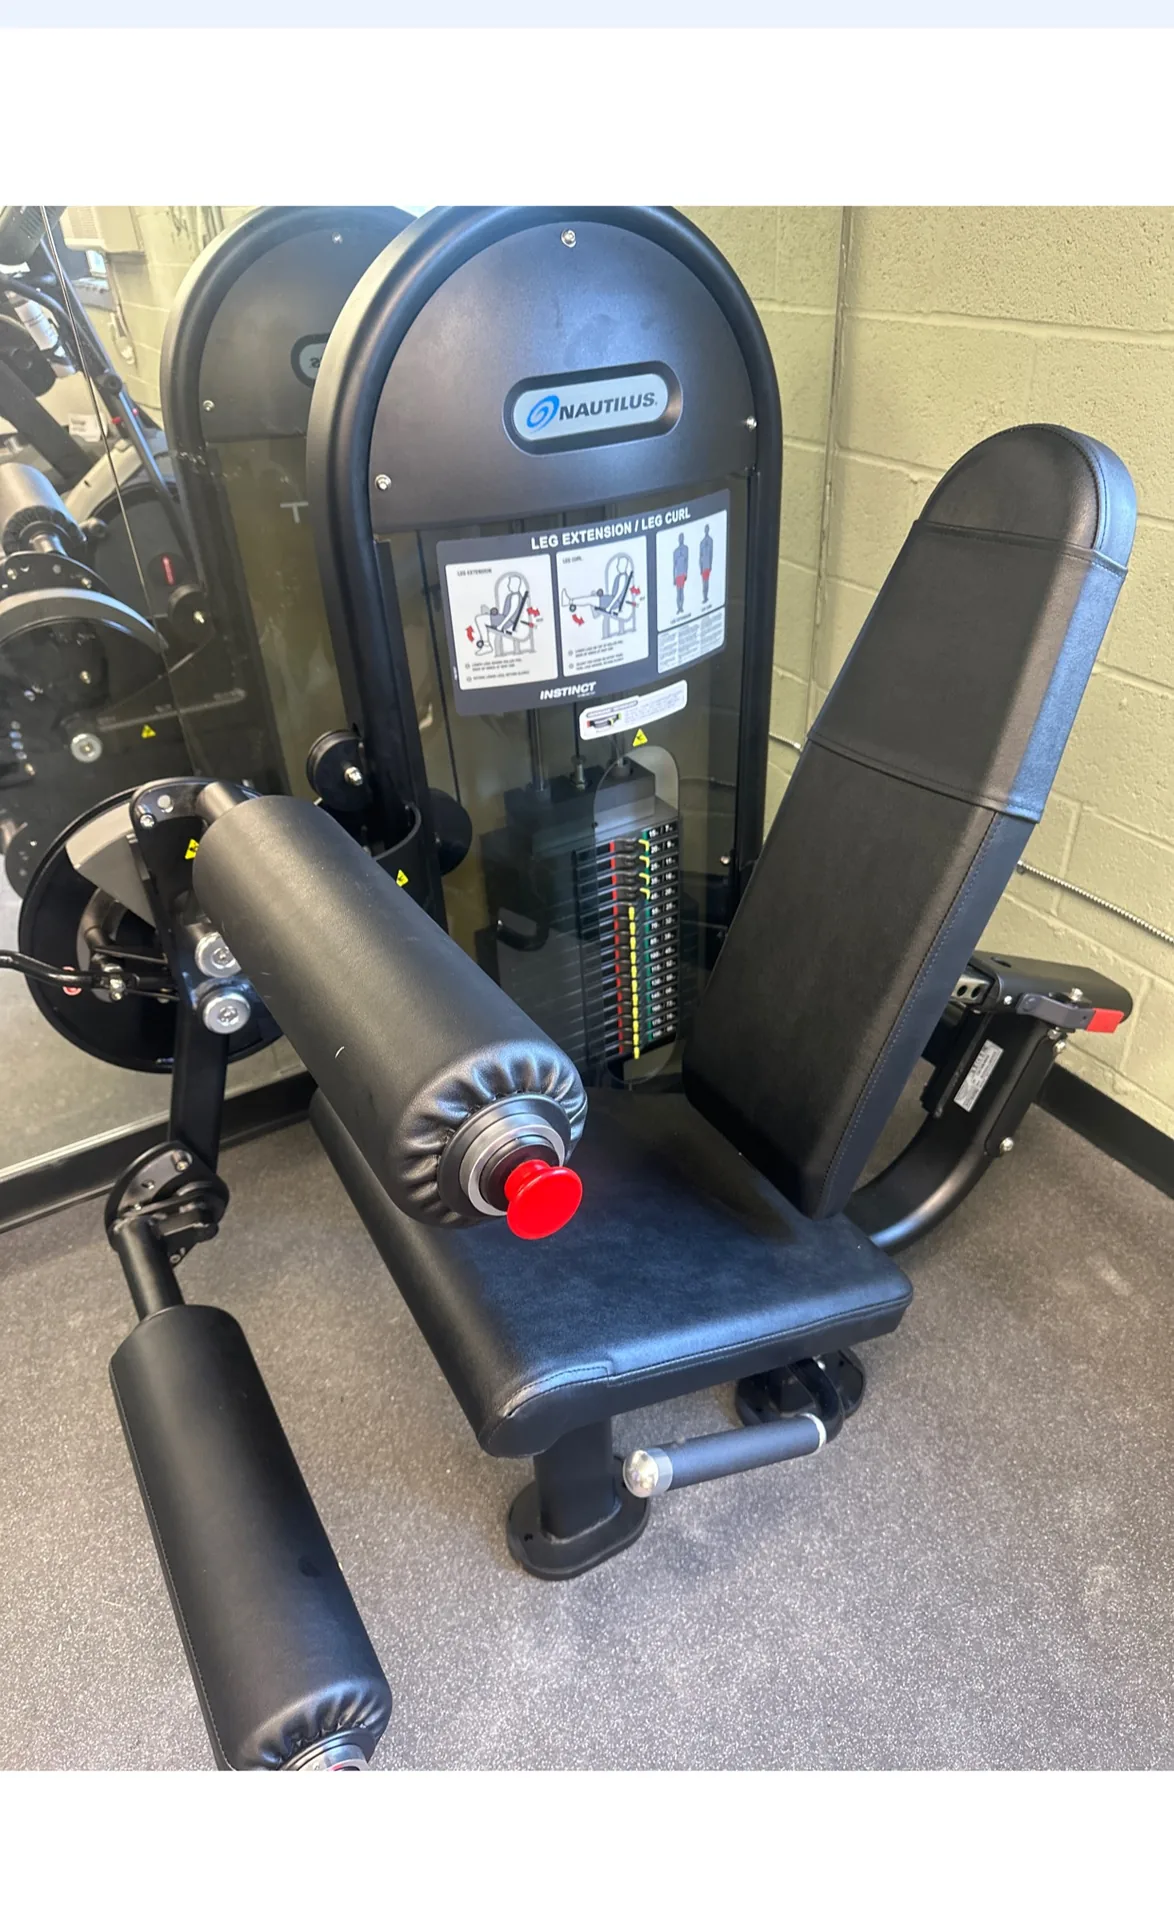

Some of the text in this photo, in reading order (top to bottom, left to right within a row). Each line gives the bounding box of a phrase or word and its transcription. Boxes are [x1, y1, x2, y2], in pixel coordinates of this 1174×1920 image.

[559, 392, 656, 420] NAUTILUS
[531, 534, 558, 550] LEG
[562, 522, 632, 546] EXTENSION
[641, 515, 663, 531] LEG
[665, 506, 691, 527] CURL
[540, 681, 597, 700] INSTINCT
